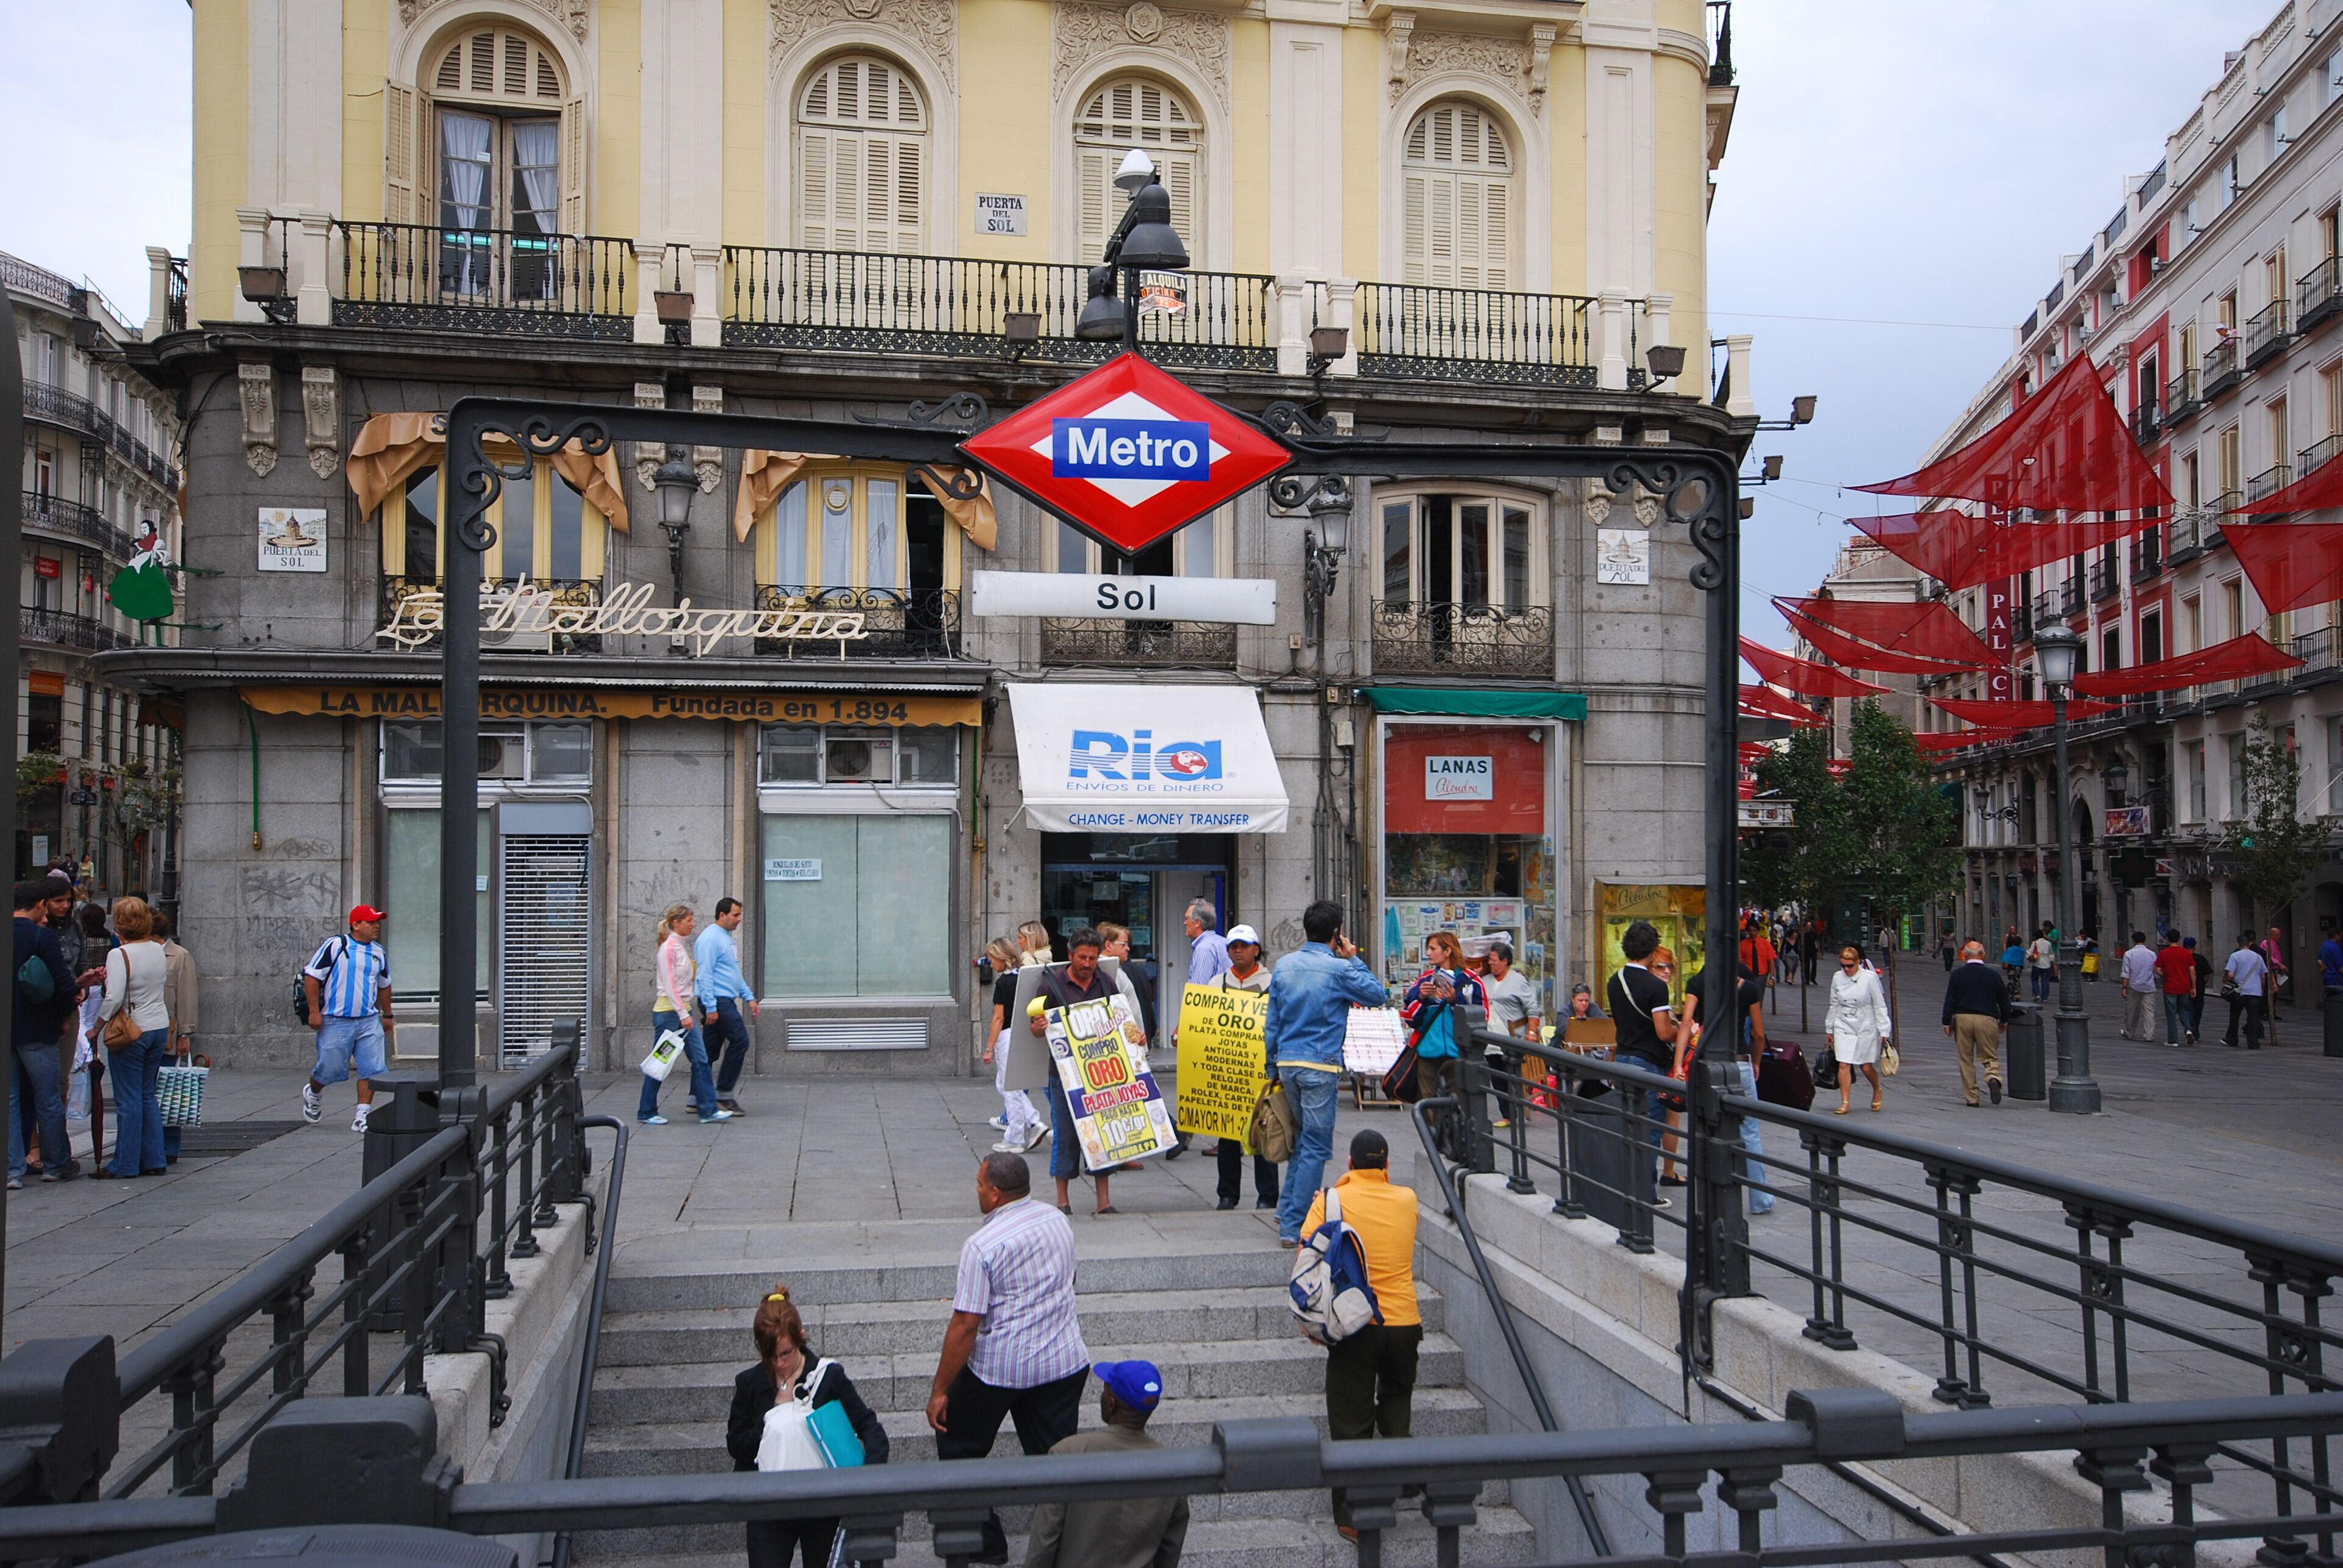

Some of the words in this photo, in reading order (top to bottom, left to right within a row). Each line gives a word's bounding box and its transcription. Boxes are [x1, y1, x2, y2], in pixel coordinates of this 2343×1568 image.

[979, 196, 1023, 209] PUERTA
[988, 219, 1014, 232] SOL
[1147, 273, 1186, 291] ALQUILA
[1141, 287, 1175, 298] OFICINA
[1068, 427, 1198, 468] Metro
[264, 546, 302, 556] PUERTA
[281, 557, 304, 567] SOL
[1599, 563, 1633, 572] PUERTA
[1607, 572, 1635, 582] SOL
[1097, 583, 1155, 610] Sol
[376, 592, 444, 645] La
[490, 572, 869, 655] Mallorquina
[1991, 594, 2007, 703] PALC
[321, 692, 361, 712] LA
[372, 692, 607, 713] MALRQUINA.
[652, 694, 774, 717] Fundada
[784, 702, 818, 718] en
[830, 701, 908, 722] 1.894
[1068, 729, 1223, 782] Ria
[1430, 760, 1488, 774] LANAS
[1164, 783, 1223, 792] DINERO
[1435, 777, 1481, 796] Alondra
[1068, 814, 1125, 825] CHANGE
[1137, 813, 1184, 825] MONEY
[1190, 814, 1250, 825] TRANSFER
[1185, 991, 1234, 1011] COMPRA
[1240, 999, 1248, 1013] Y
[1068, 1004, 1110, 1040] ORO
[1218, 1013, 1255, 1030] ORO
[1189, 1024, 1217, 1035] PLATA
[1220, 1029, 1265, 1041] COMPRAM
[1078, 1037, 1118, 1059] COMPRO
[1204, 1045, 1249, 1058] ANTIGUAS
[1218, 1038, 1247, 1049] JOYAS
[1200, 1063, 1224, 1073] TODA
[1226, 1067, 1254, 1077] CLASE
[1206, 1055, 1255, 1068] MODERNAS
[1087, 1057, 1125, 1087] ORO
[1211, 1073, 1250, 1086] RELOJES
[1083, 1091, 1117, 1112] PLATA
[1117, 1082, 1148, 1104] JOYAS
[1191, 1088, 1222, 1099] ROLEX,
[1225, 1093, 1256, 1105] CARTIE
[1220, 1084, 1254, 1096] MARCA:
[1179, 1095, 1229, 1109] PAPELETAS
[1101, 1107, 1118, 1121] PAGO
[1119, 1103, 1140, 1115] HASTA
[1178, 1106, 1218, 1132] C/MAYOR
